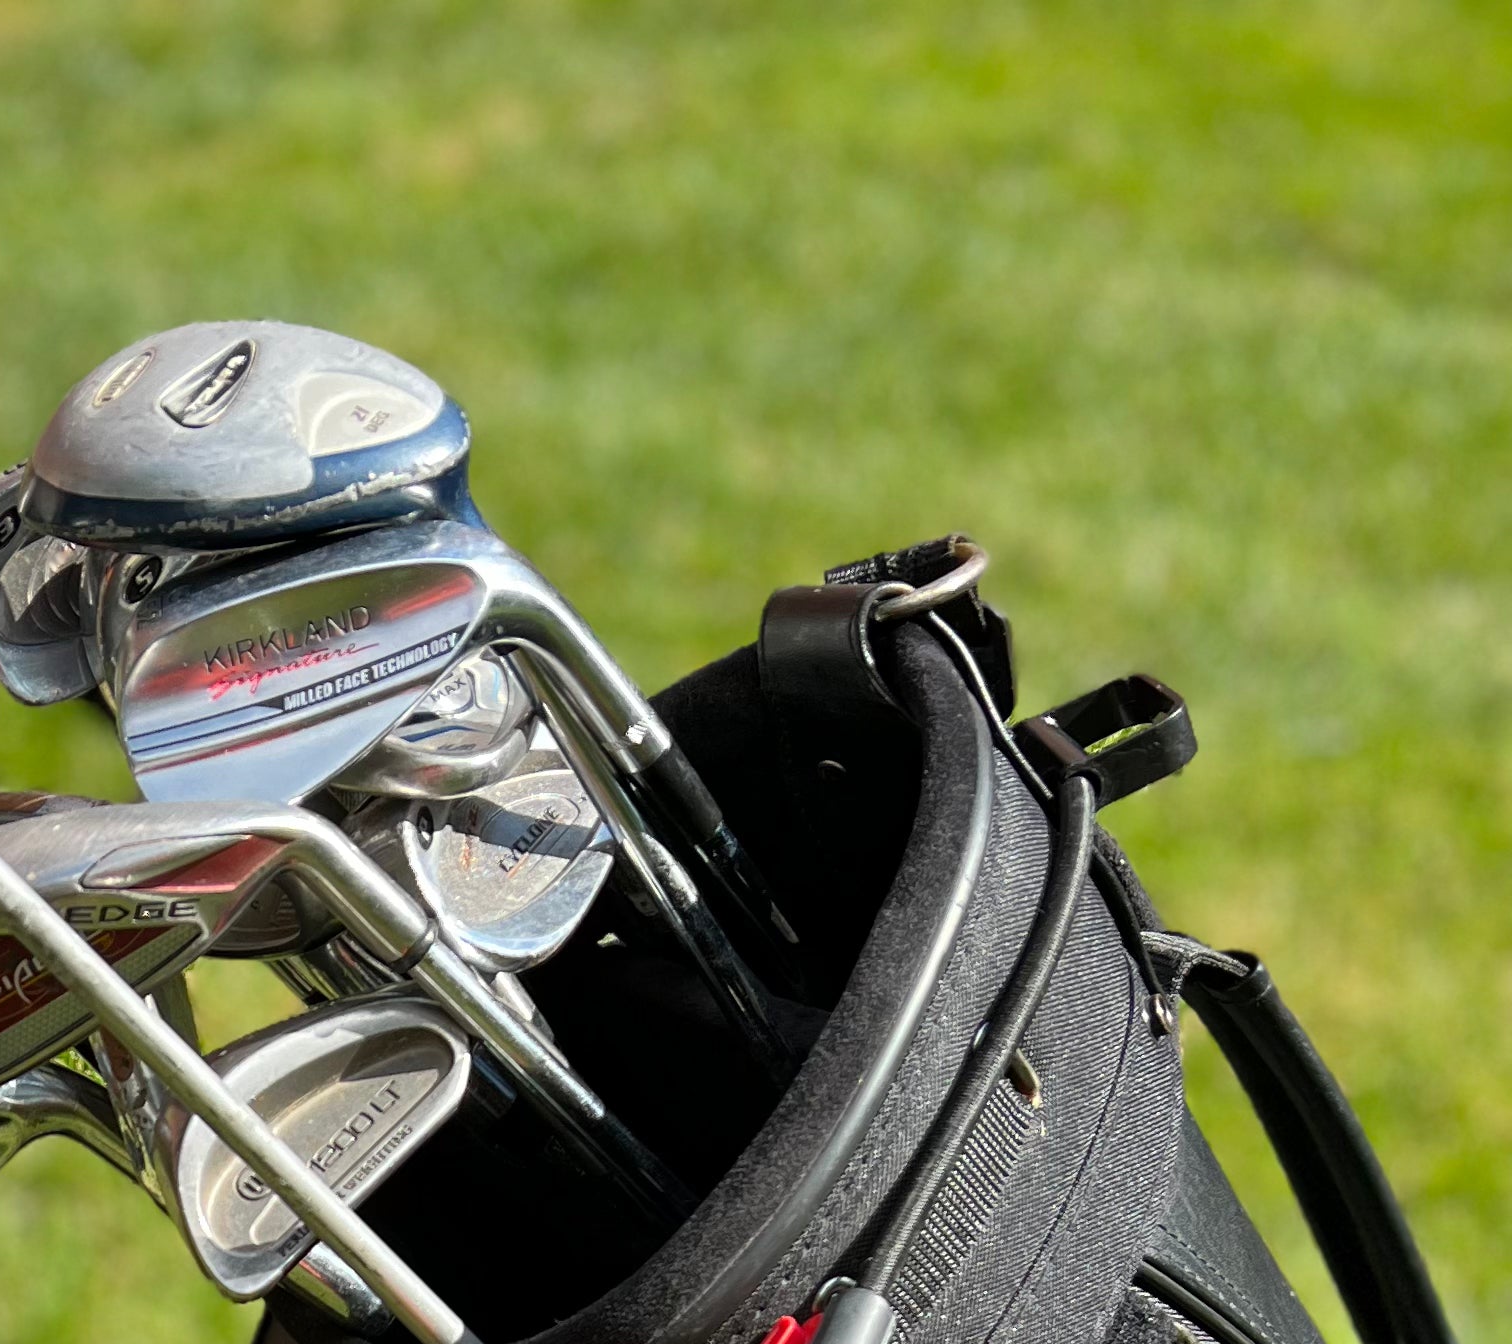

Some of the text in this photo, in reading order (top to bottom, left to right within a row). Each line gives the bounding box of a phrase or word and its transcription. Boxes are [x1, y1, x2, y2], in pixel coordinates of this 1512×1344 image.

[362, 410, 390, 433] DEG
[134, 564, 154, 593] 5
[203, 605, 371, 674] KIRKLAND
[283, 632, 458, 712] MILLED FACE TECHNOLOGY
[429, 678, 467, 703] MAX
[497, 806, 561, 873] CYCLONE
[305, 1078, 401, 1174] 1200 LT
